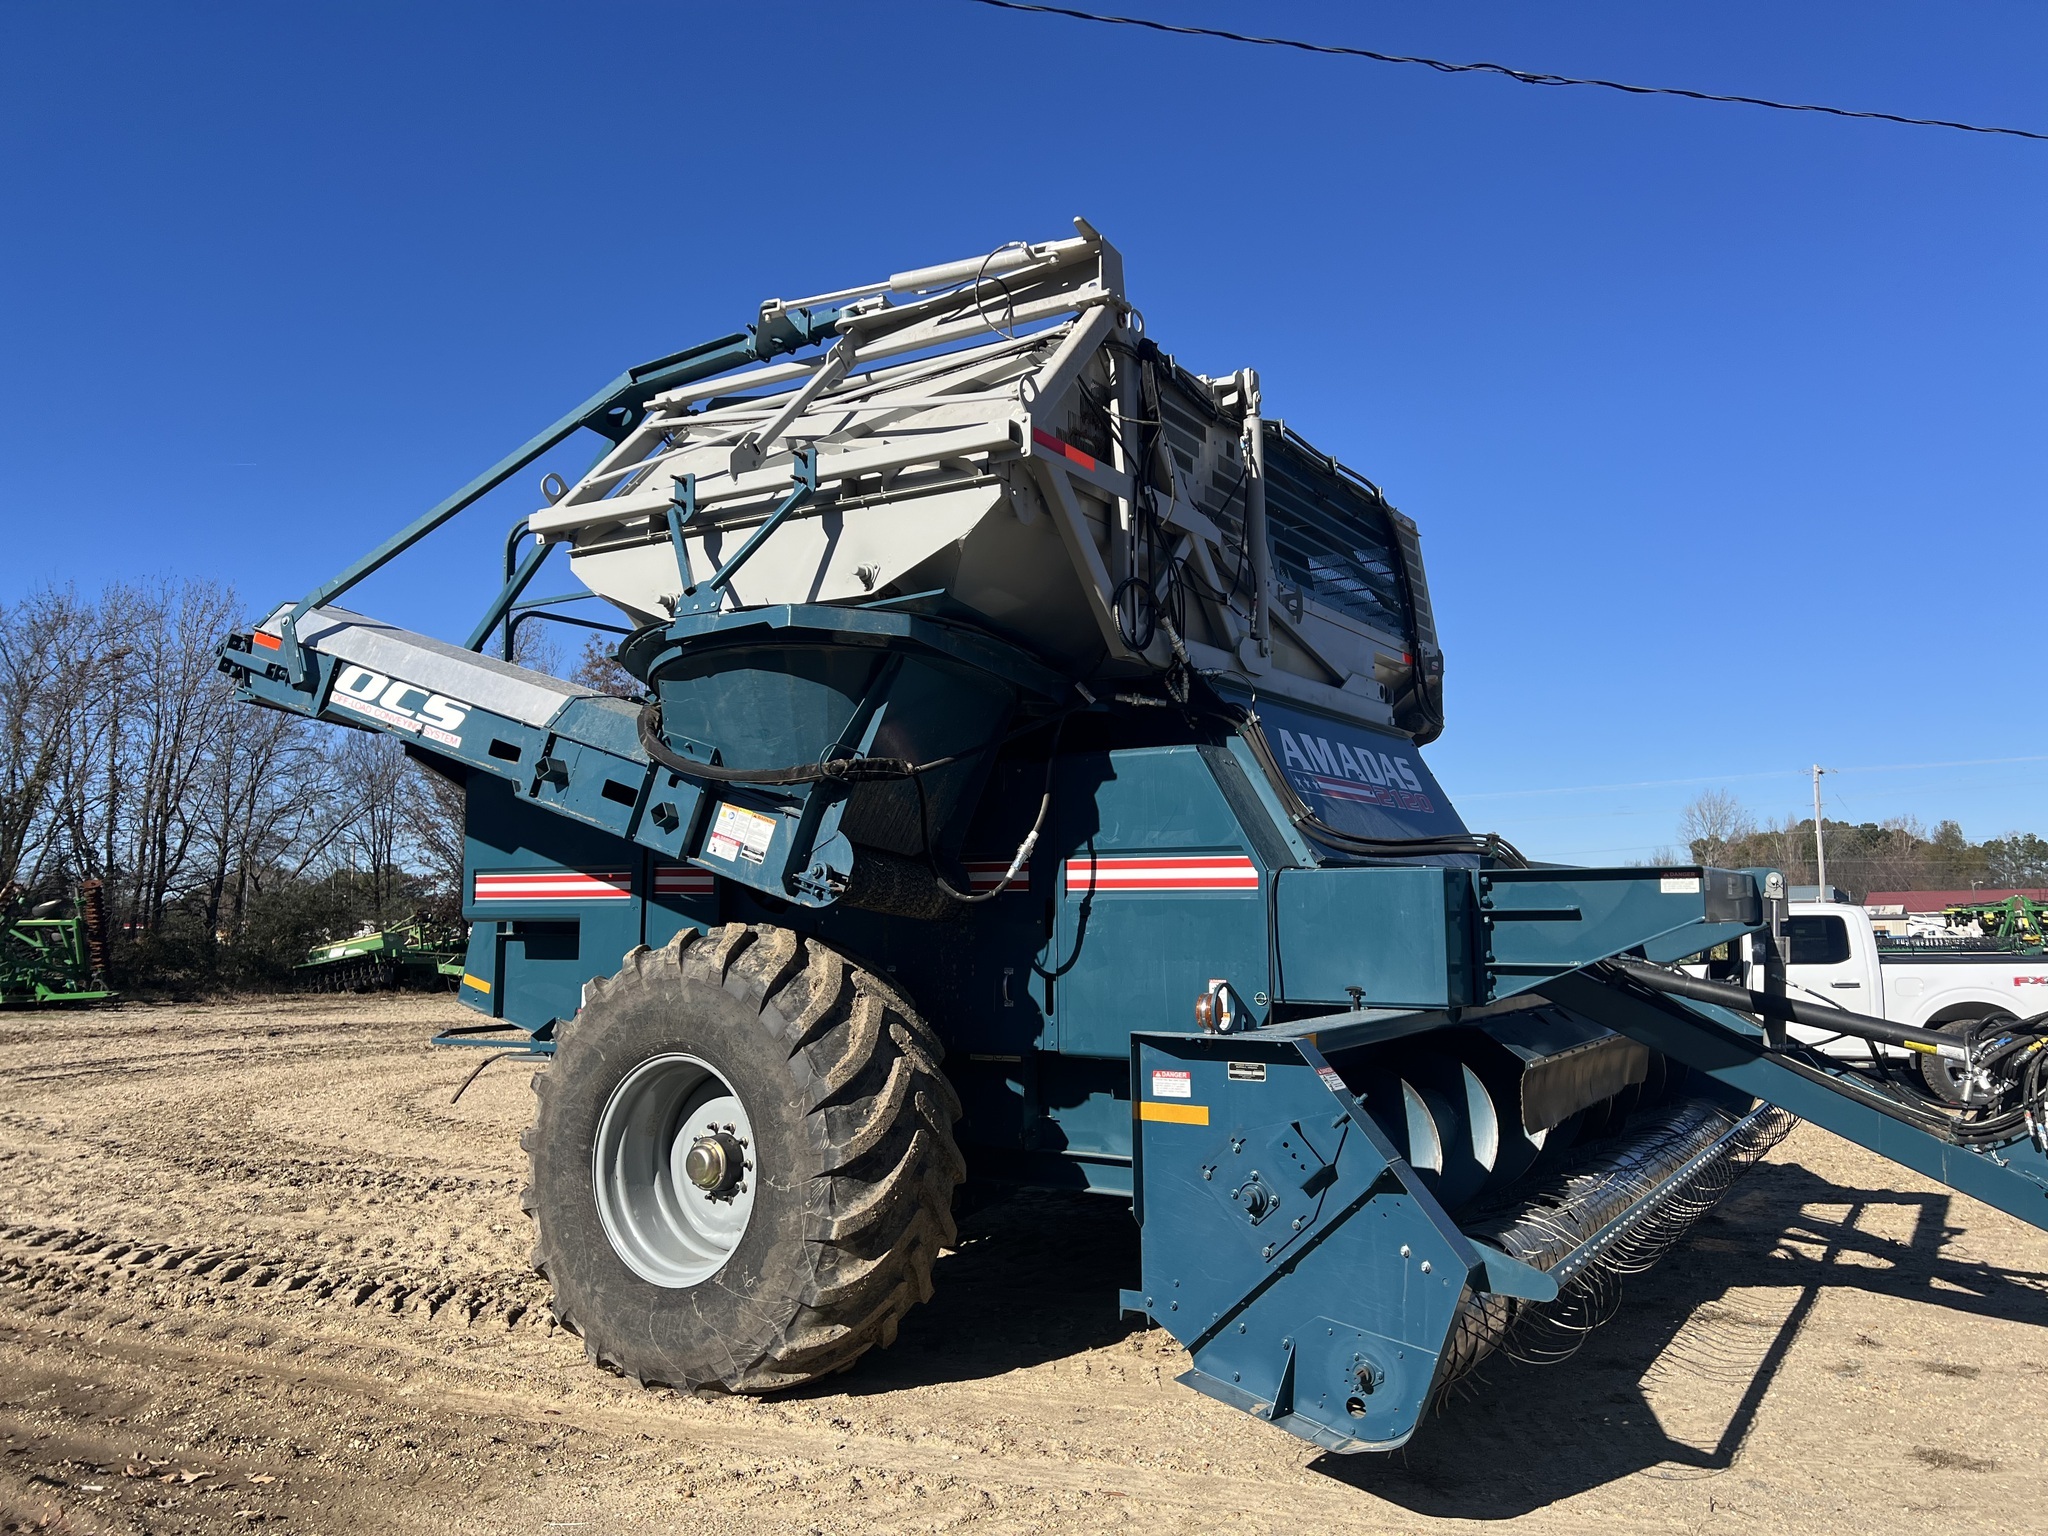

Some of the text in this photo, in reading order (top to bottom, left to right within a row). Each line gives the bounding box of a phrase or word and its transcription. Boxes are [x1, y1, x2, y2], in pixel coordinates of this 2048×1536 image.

[332, 693, 460, 746] OFF-LOAD CONVEYING SYSTEM
[334, 665, 472, 731] OCS
[1278, 727, 1422, 792] AMADAS
[1372, 785, 1434, 813] 2120
[2014, 976, 2048, 987] FX
